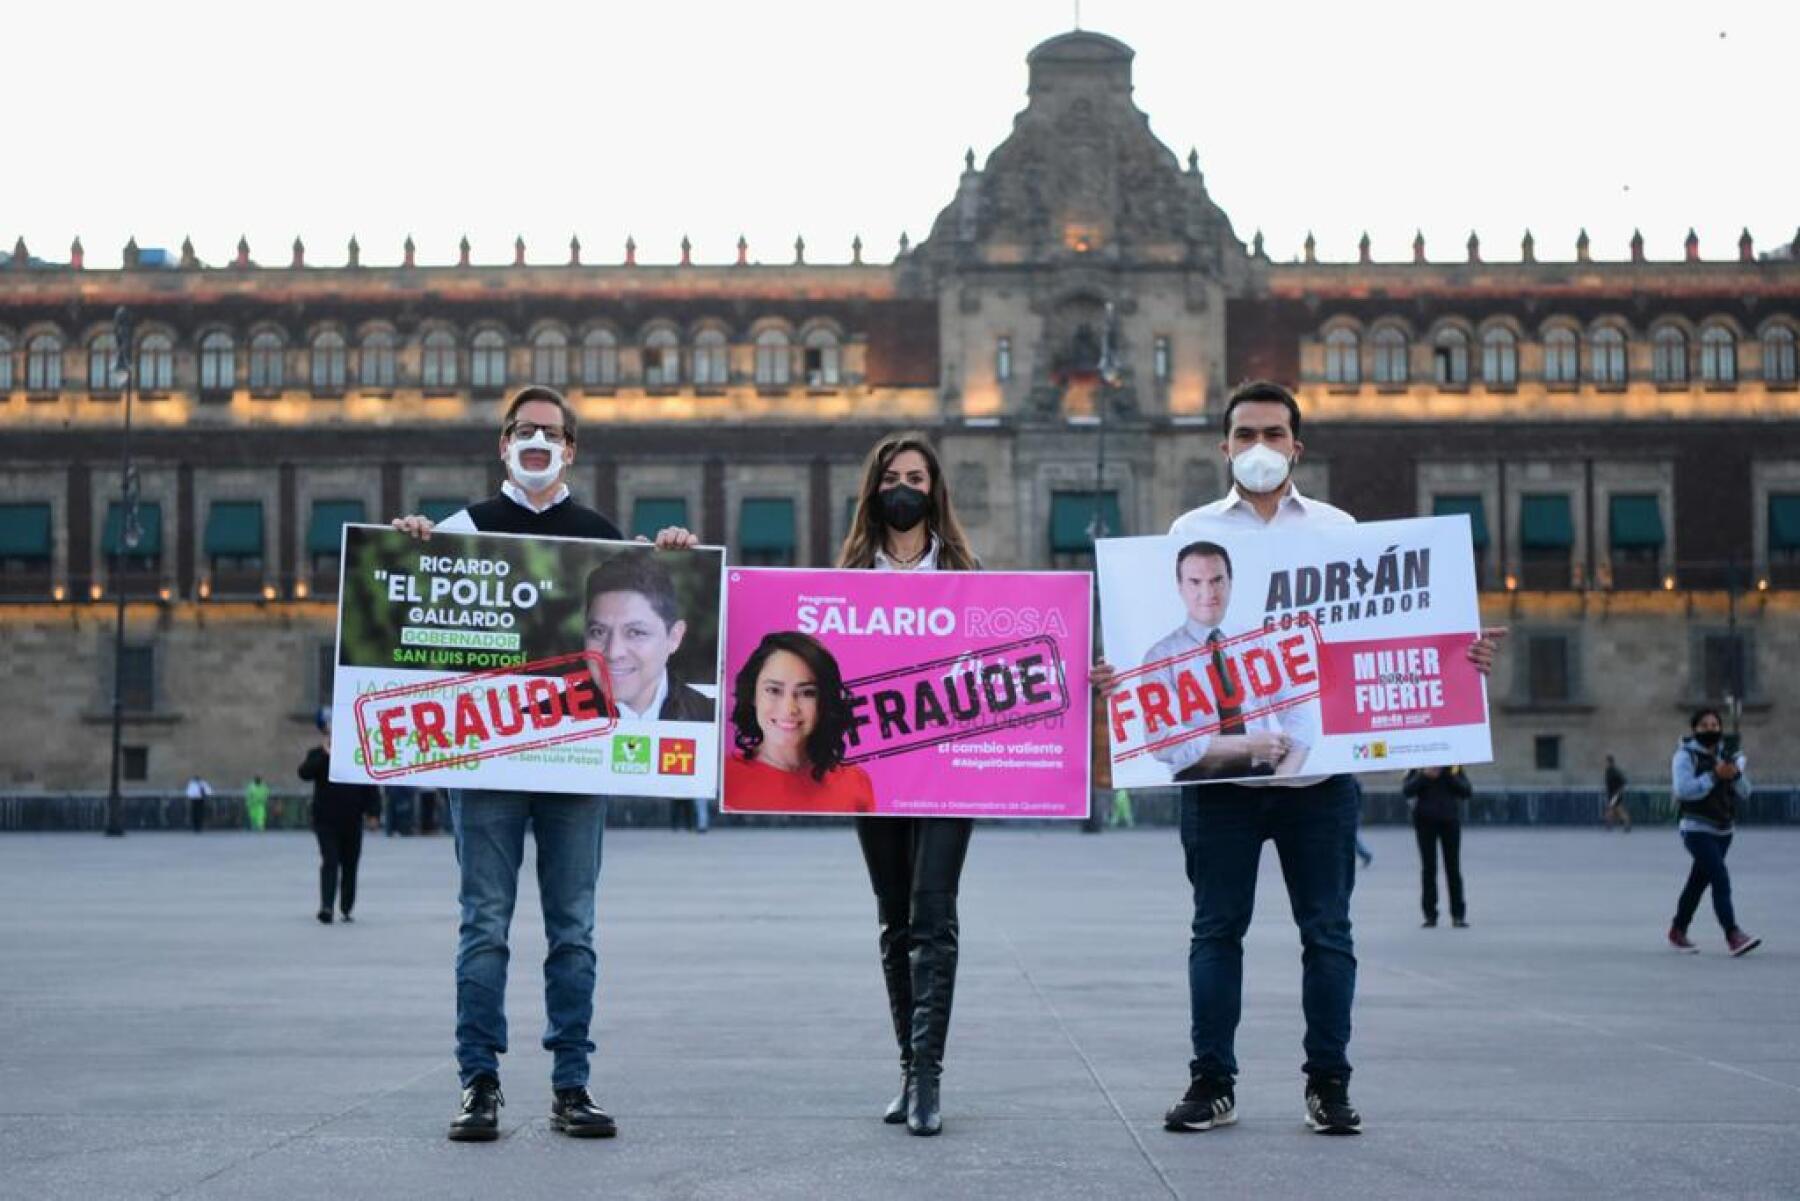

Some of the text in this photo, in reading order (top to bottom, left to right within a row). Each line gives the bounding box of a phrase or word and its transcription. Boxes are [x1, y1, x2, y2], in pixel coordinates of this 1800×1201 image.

[419, 554, 510, 577] RICARDO
[373, 569, 554, 609] "EL POLLO"
[408, 606, 516, 628] GALLARDO
[797, 605, 1069, 638] SALARIO ROSA
[1263, 590, 1431, 633] GOBERNADOR
[404, 630, 518, 647] GOBERNADOR
[393, 648, 528, 667] SAN LUIS POTOSÍ
[1353, 647, 1440, 681] MUJER
[845, 653, 1051, 747] FRAUDE
[1110, 633, 1317, 744] FRAUDE
[1355, 679, 1445, 714] FUERTE
[376, 668, 599, 760] FRAUDE
[662, 752, 694, 773] PT
[952, 741, 1005, 754] cambio
[1007, 742, 1063, 754] valiente
